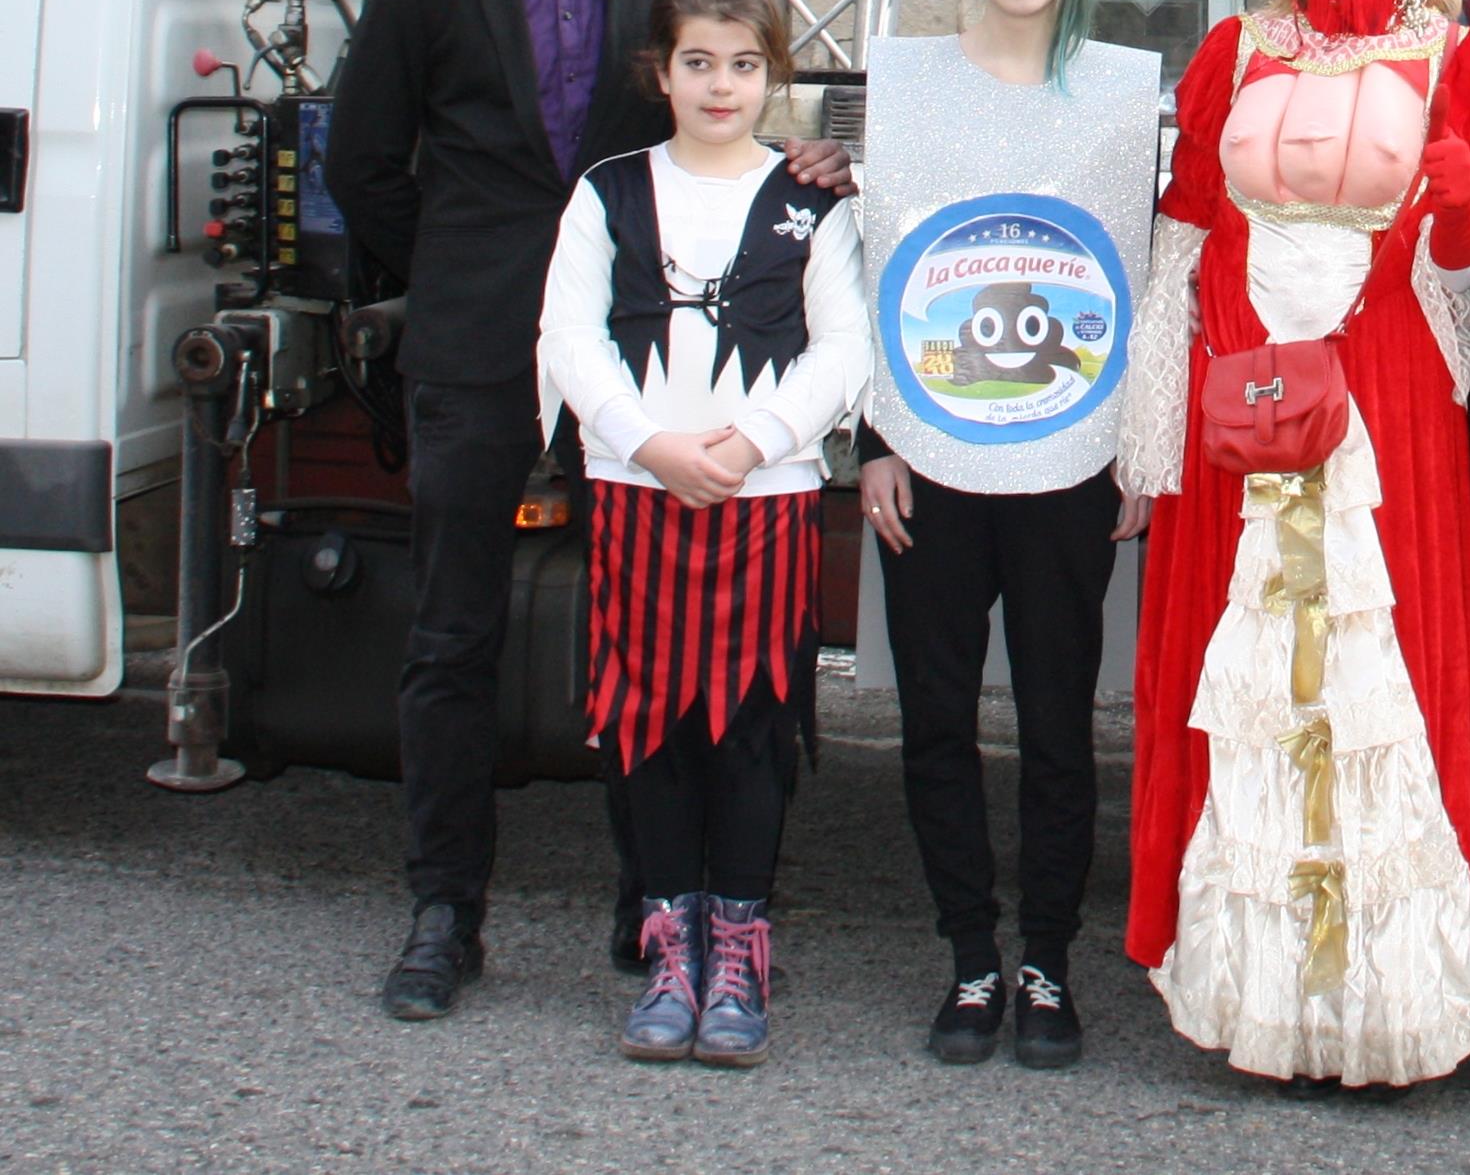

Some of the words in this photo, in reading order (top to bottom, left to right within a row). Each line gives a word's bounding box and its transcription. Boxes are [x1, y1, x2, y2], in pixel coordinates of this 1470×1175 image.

[1000, 223, 1021, 239] 16
[926, 266, 950, 289] La
[953, 255, 1010, 279] Caca
[1013, 257, 1055, 276] que
[1060, 257, 1087, 279] ríe
